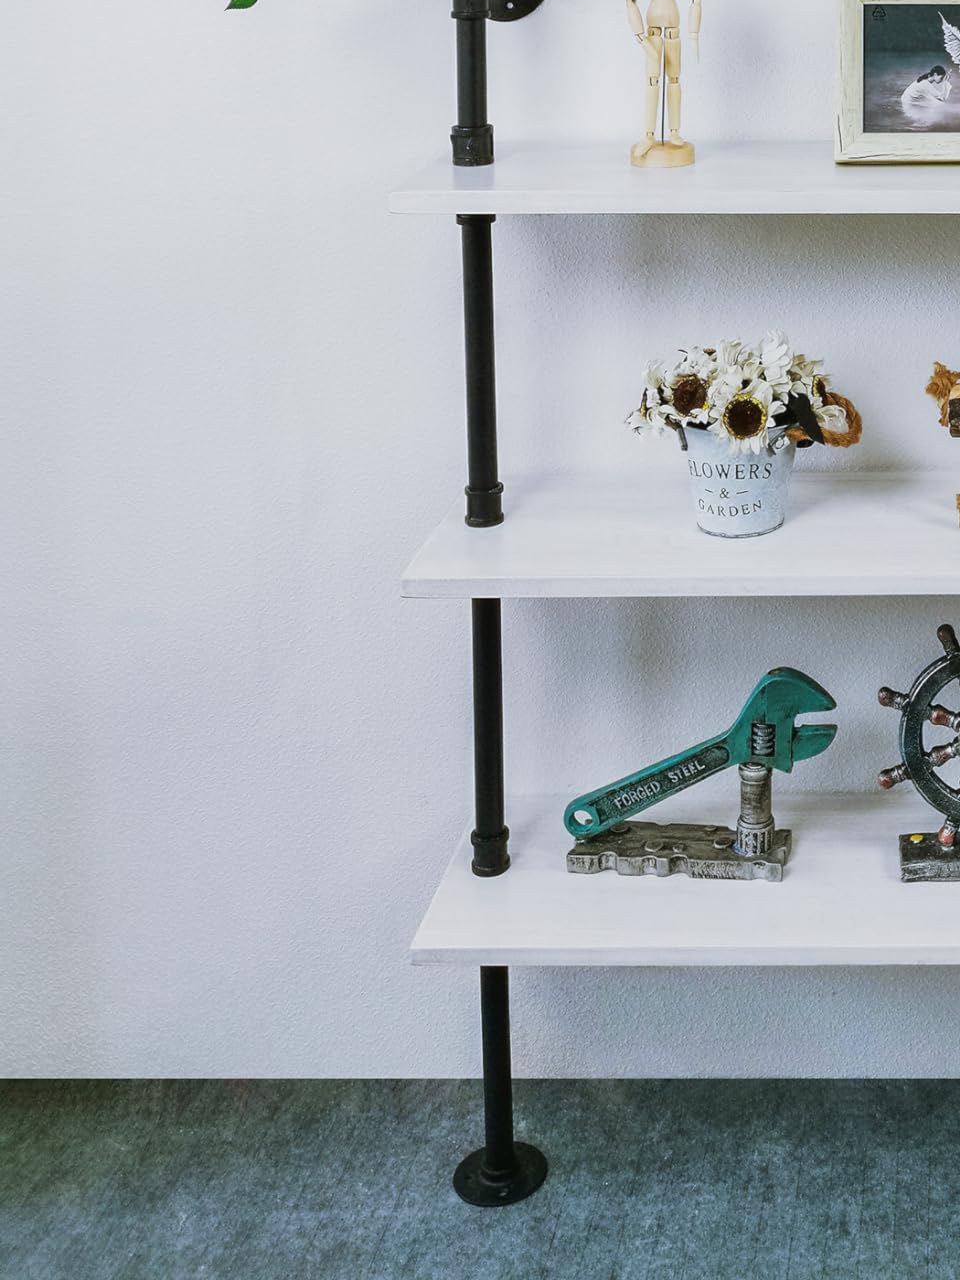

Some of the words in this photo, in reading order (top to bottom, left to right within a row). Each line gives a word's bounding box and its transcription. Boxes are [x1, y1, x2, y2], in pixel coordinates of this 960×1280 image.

[719, 487, 730, 499] &
[698, 498, 762, 517] GARDEN
[614, 780, 661, 810] FORGED
[667, 760, 706, 783] STEEL
